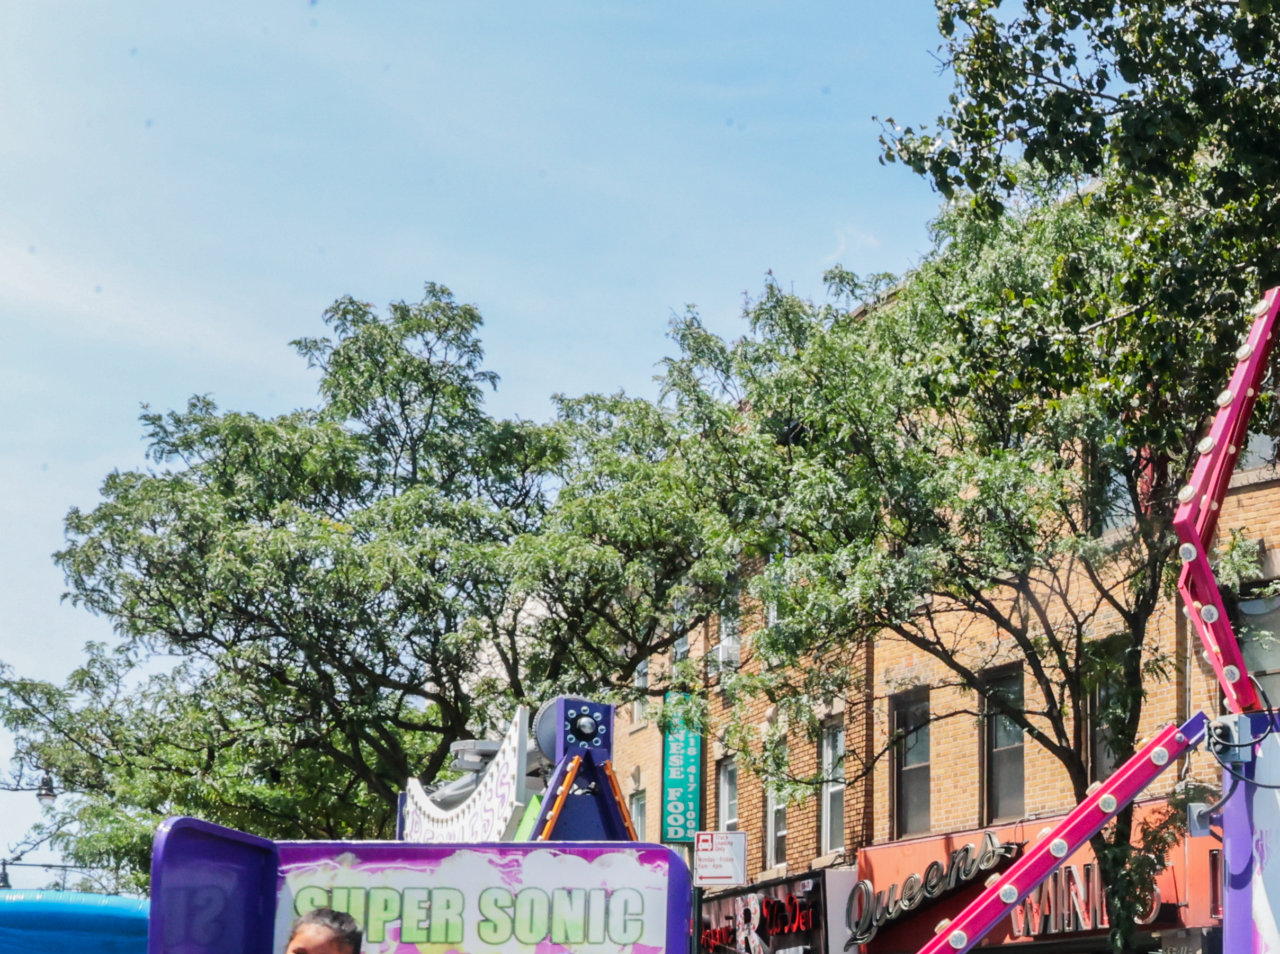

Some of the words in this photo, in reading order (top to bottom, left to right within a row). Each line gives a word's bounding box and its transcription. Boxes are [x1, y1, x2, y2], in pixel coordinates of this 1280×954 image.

[667, 788, 685, 839] FOOD
[478, 886, 644, 945] SONIC
[843, 829, 1018, 952] Queens
